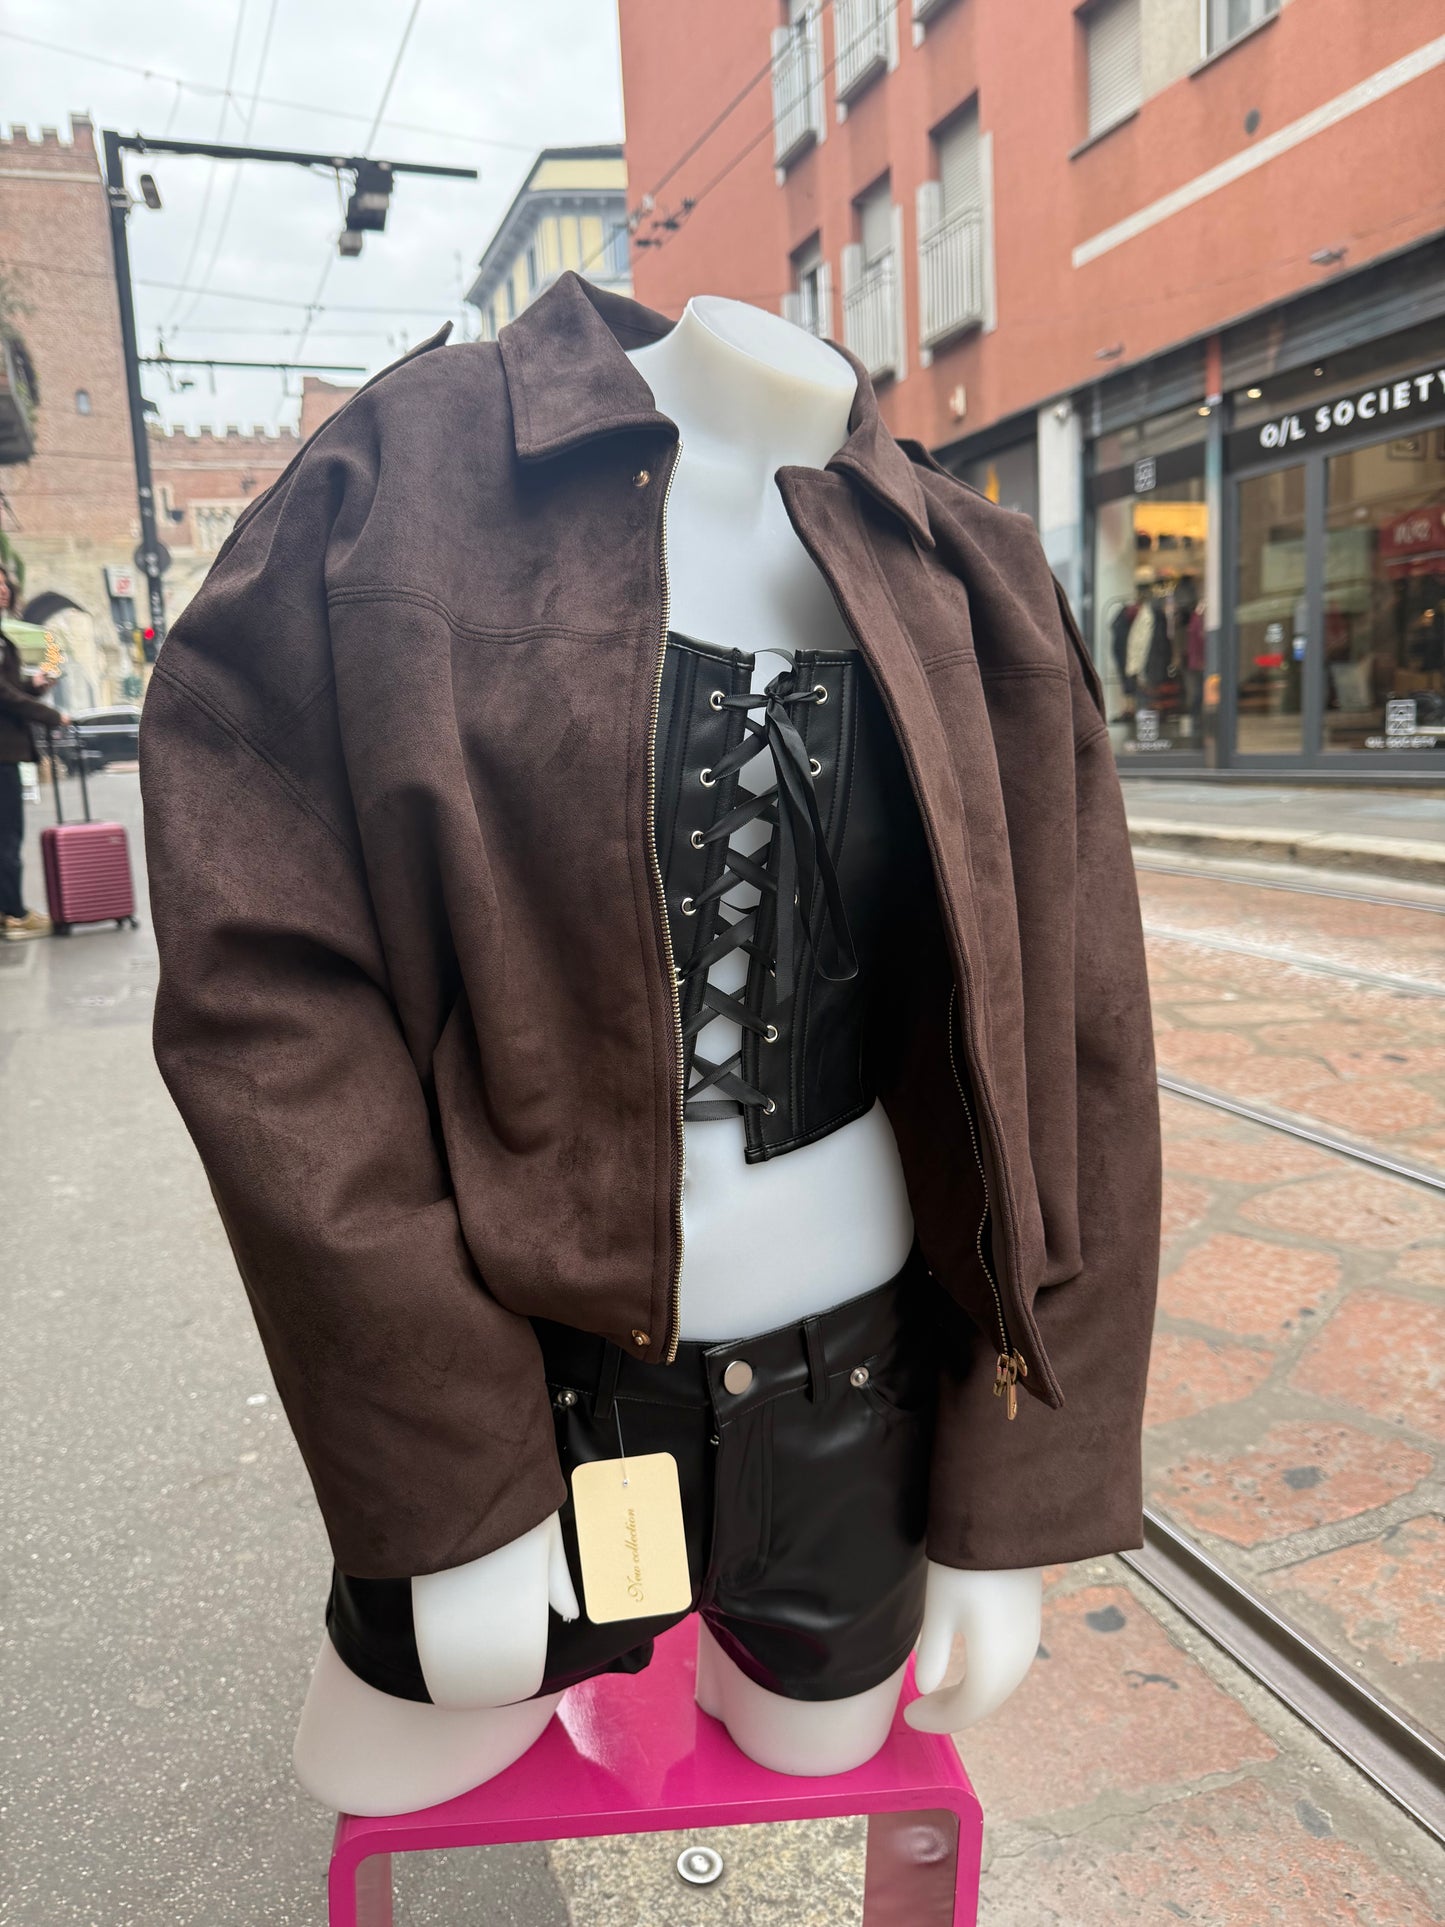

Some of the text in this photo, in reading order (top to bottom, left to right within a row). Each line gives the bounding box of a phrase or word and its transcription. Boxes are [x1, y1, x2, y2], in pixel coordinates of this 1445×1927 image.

[1259, 415, 1306, 448] O/L
[625, 1508, 644, 1602] New collection
